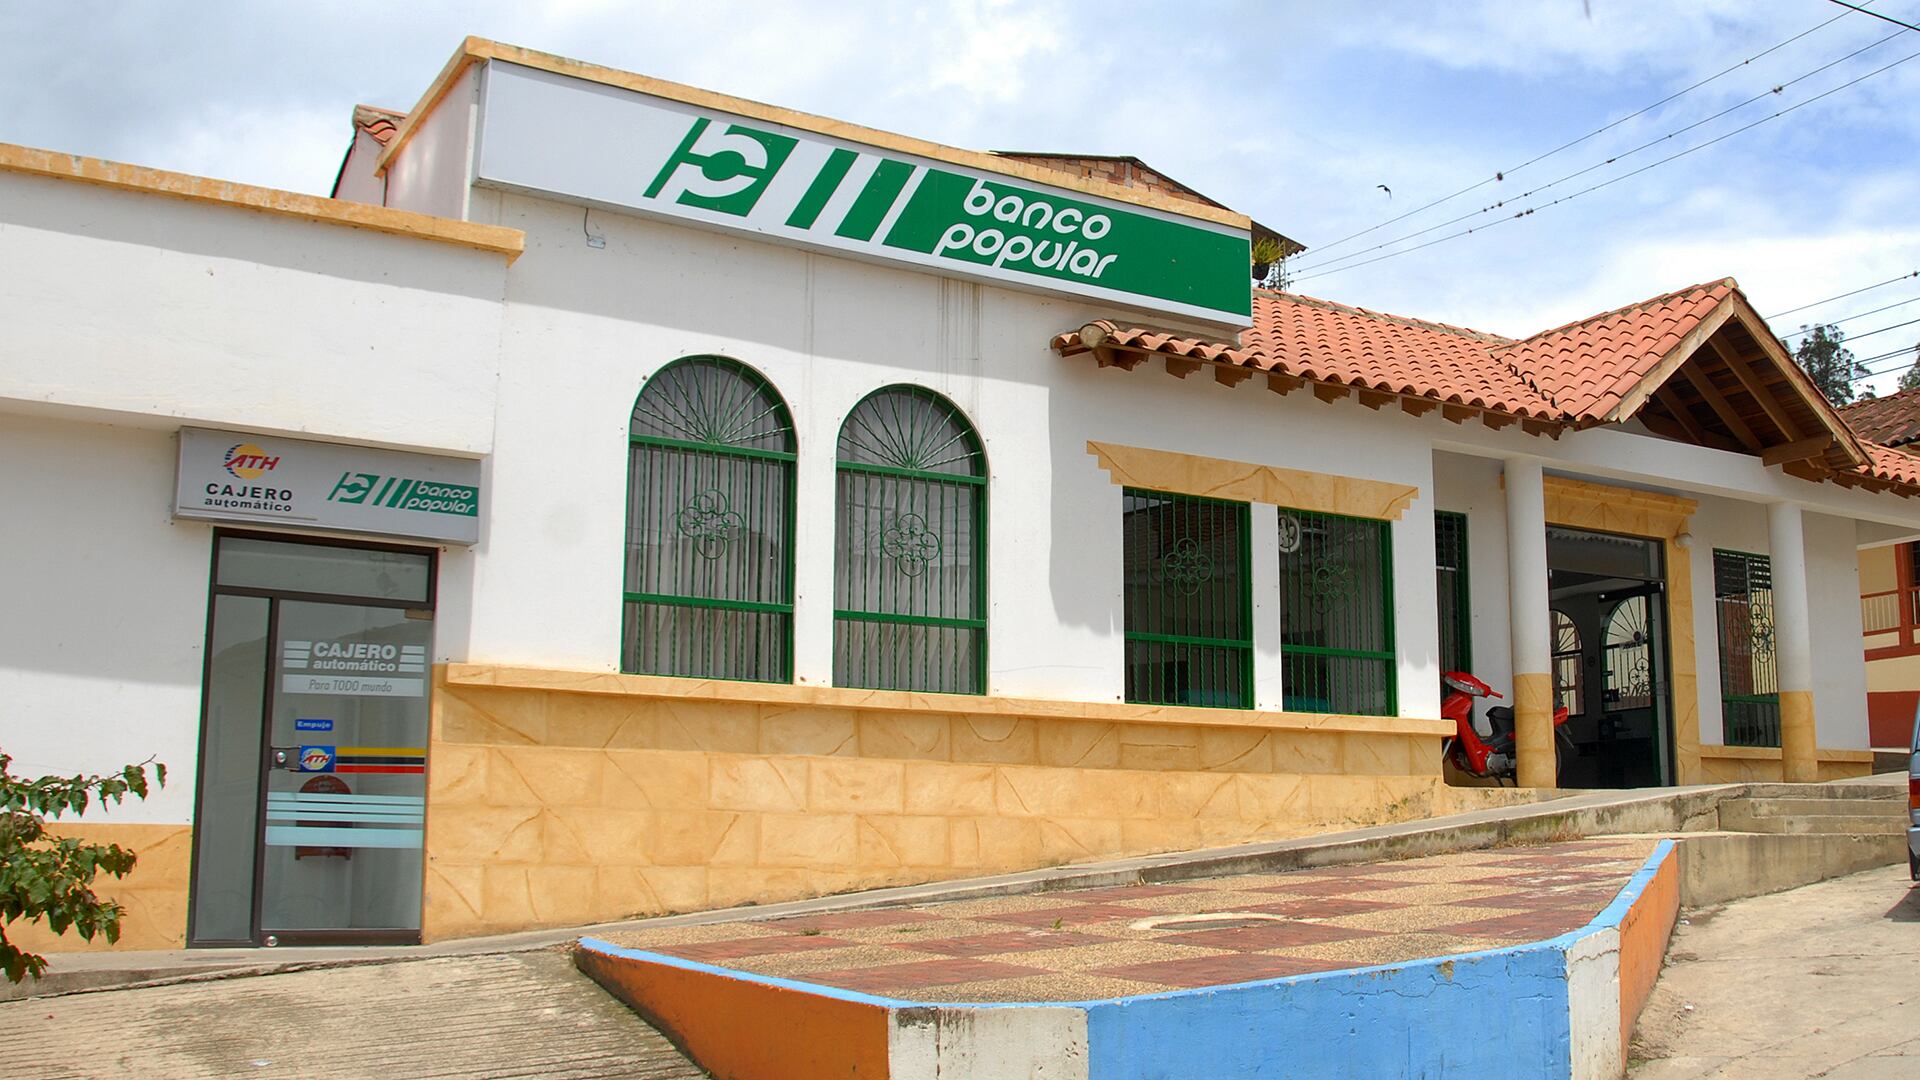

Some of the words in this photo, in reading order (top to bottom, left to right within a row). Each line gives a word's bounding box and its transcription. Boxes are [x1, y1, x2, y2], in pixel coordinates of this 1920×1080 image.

[963, 178, 1111, 240] banco
[931, 223, 1118, 279] popular
[223, 454, 280, 471] ATH
[206, 483, 292, 501] CAJERO
[417, 481, 473, 499] banco
[204, 498, 292, 512] automático
[404, 498, 475, 513] popular
[313, 642, 397, 660] CAJERO
[312, 659, 396, 672] automático
[308, 679, 330, 690] Para
[332, 680, 360, 692] TODO
[297, 721, 332, 729] Empuje
